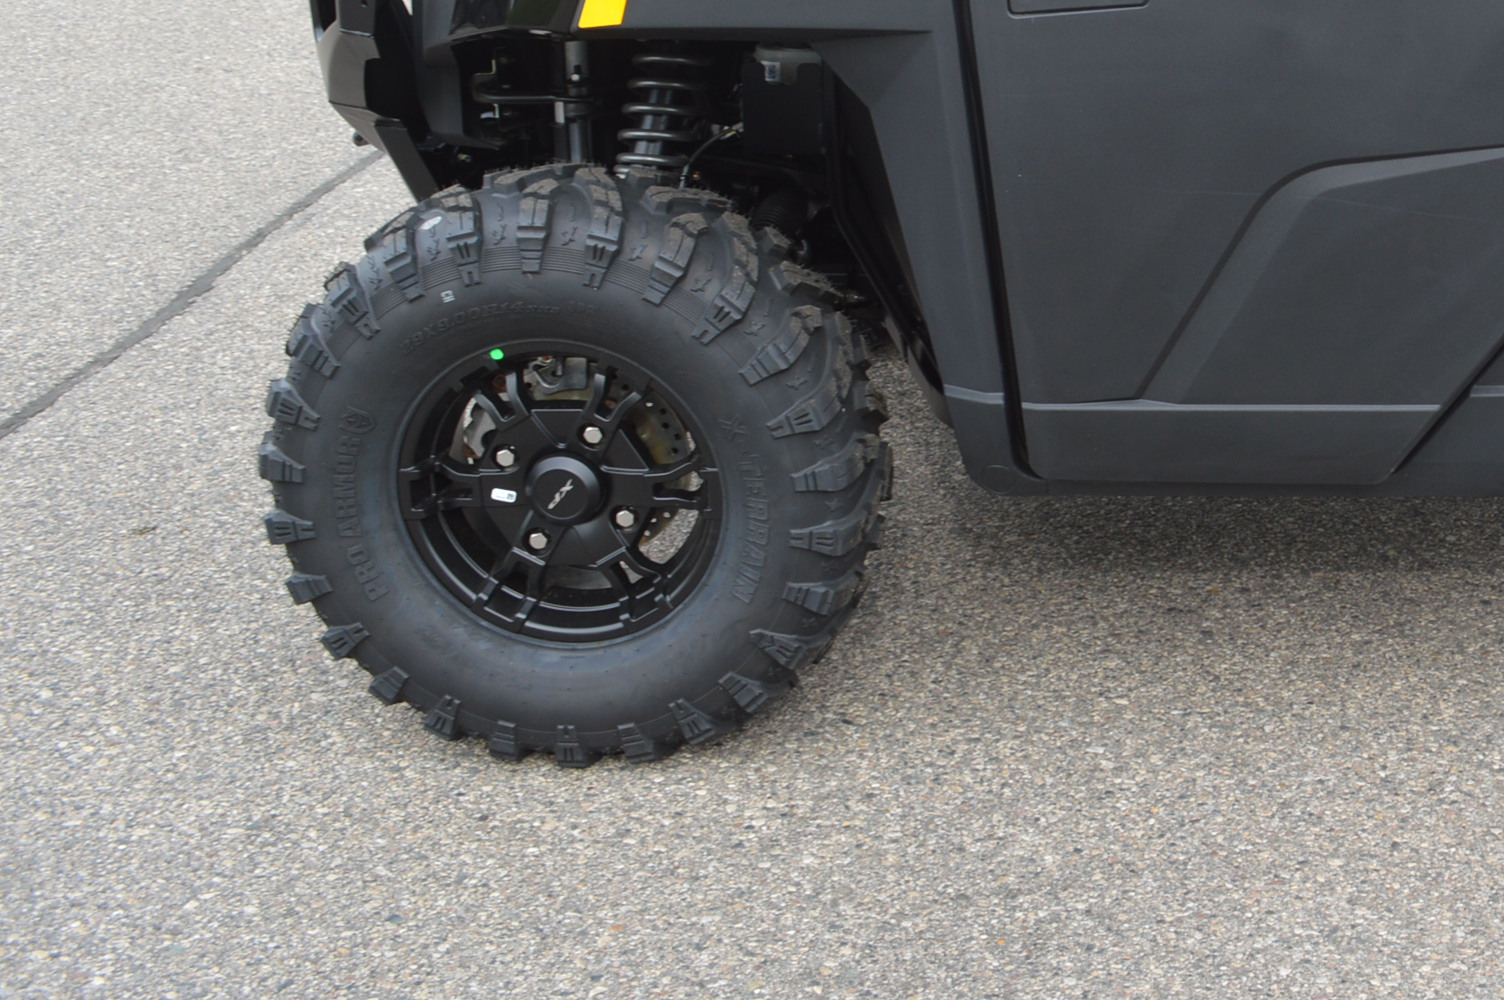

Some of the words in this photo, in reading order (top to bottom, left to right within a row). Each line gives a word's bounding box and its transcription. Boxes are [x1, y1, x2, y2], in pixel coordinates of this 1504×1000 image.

[333, 436, 362, 537] ARMOR
[547, 479, 574, 510] XP
[348, 545, 390, 602] PRO
